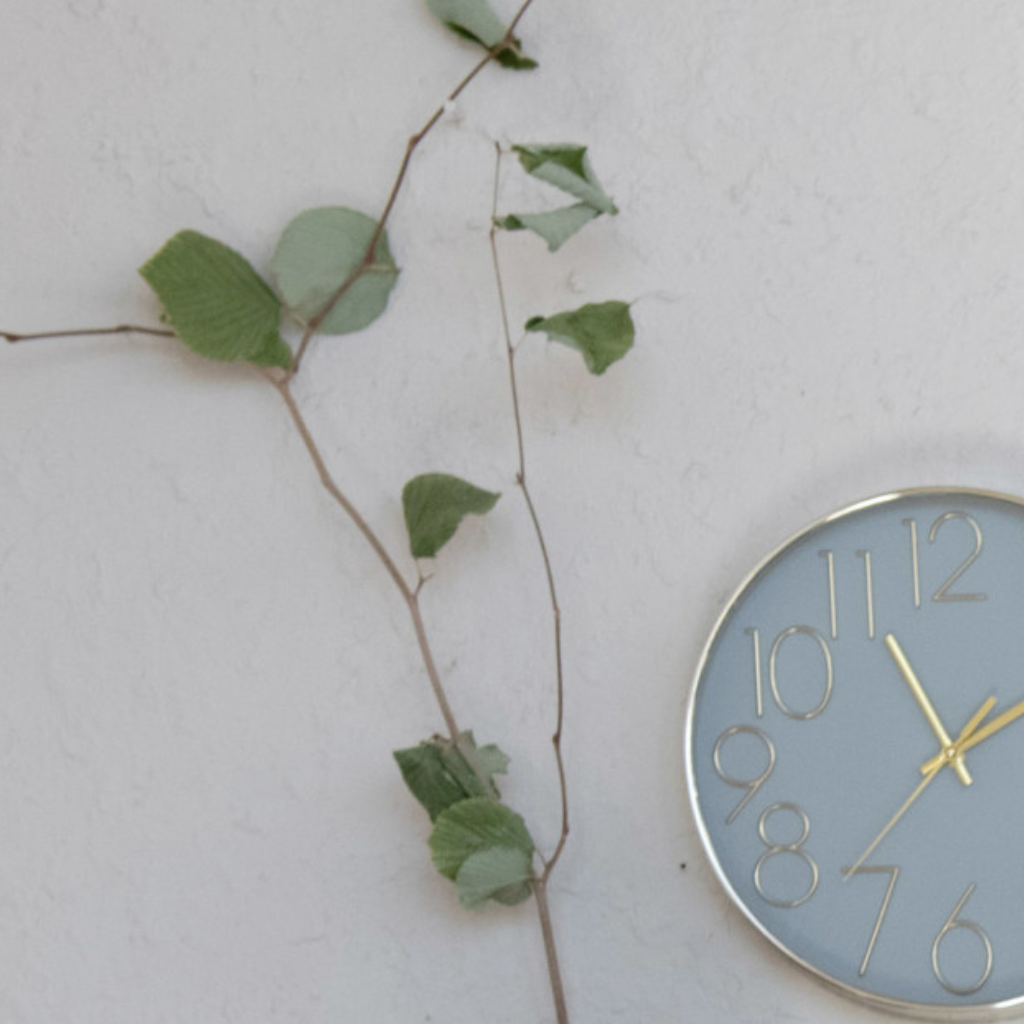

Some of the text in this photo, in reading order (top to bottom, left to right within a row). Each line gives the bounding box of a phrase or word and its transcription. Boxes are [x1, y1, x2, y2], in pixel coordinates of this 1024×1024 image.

[818, 549, 875, 639] 11
[902, 511, 987, 606] 12
[744, 625, 834, 720] 10
[713, 725, 775, 824] 9
[754, 803, 818, 908] 8
[841, 866, 899, 976] 7
[932, 883, 993, 996] 6
